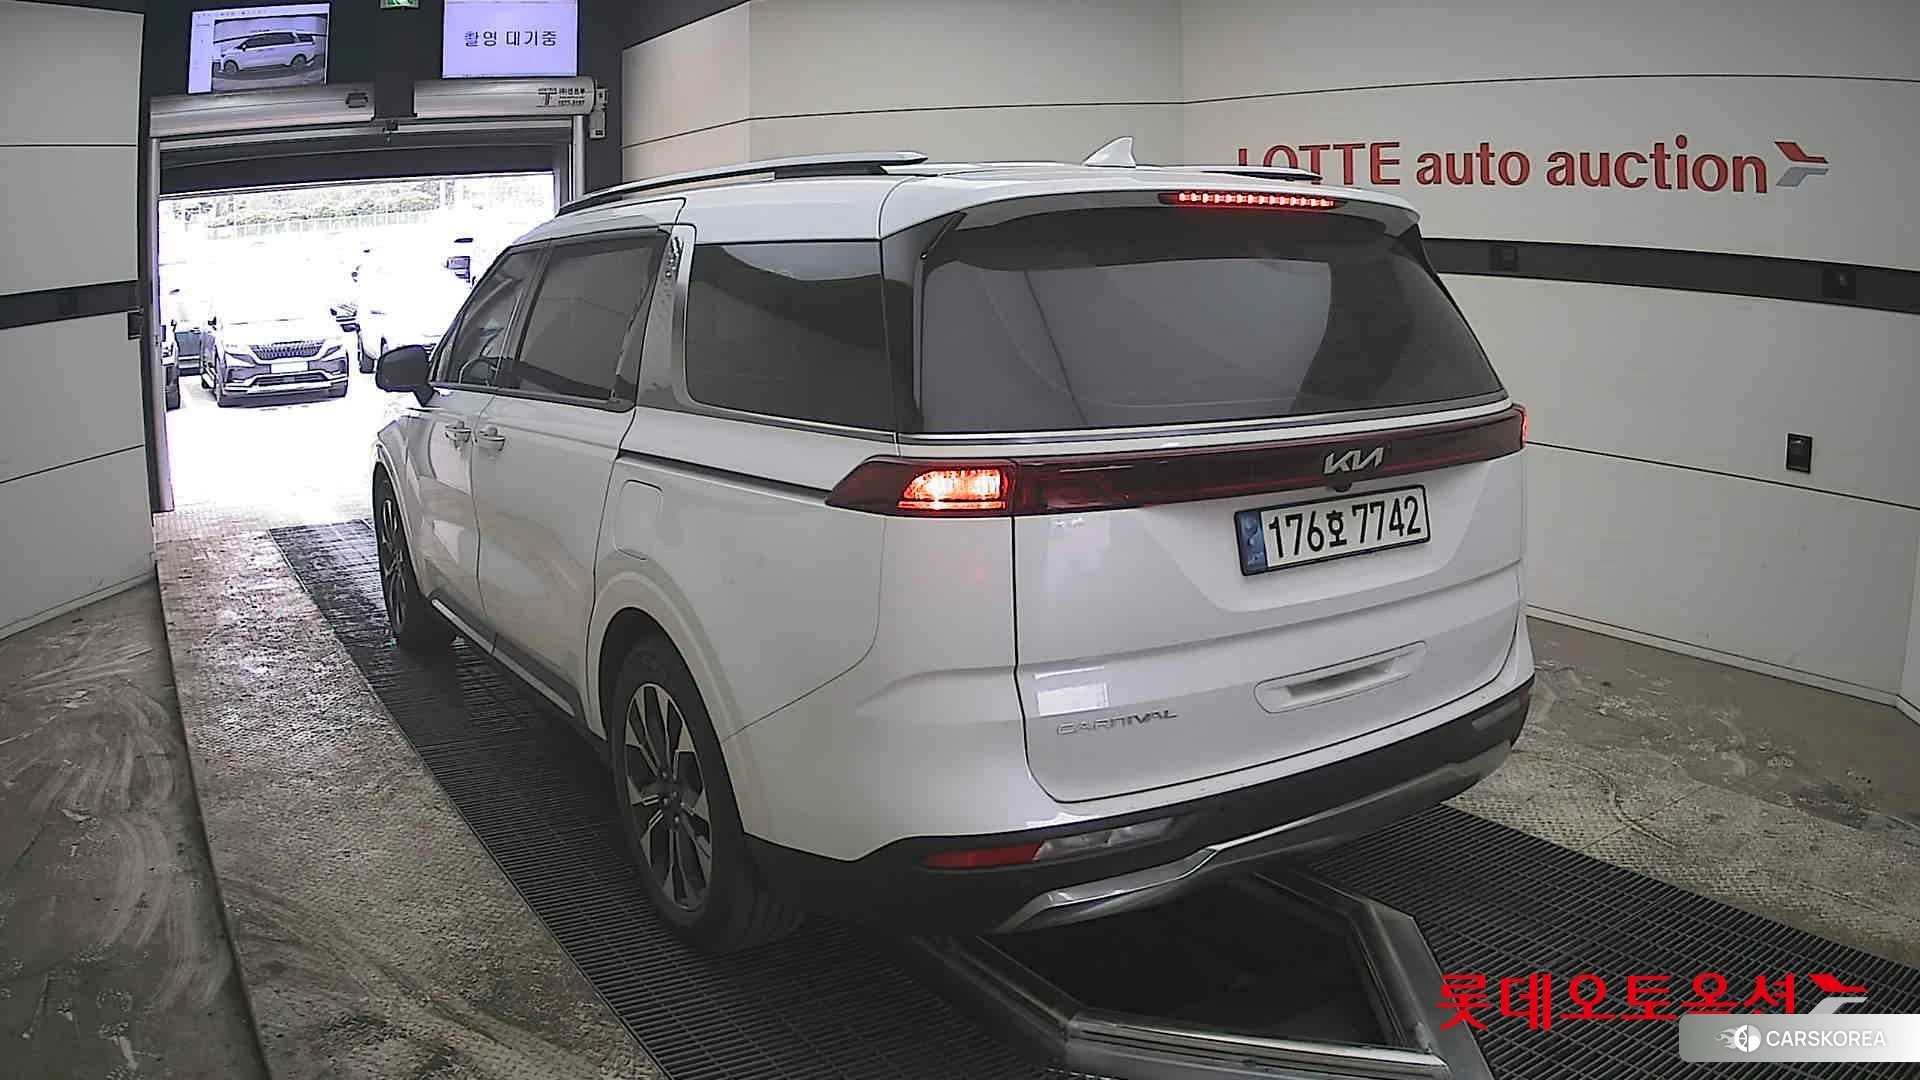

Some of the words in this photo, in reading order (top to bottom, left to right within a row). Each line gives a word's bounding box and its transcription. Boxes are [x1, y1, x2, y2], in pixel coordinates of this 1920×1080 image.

[506, 30, 557, 47] 대기중
[1416, 142, 1530, 186] auto
[1546, 134, 1768, 193] auction
[1056, 710, 1178, 736] CARNIVAL
